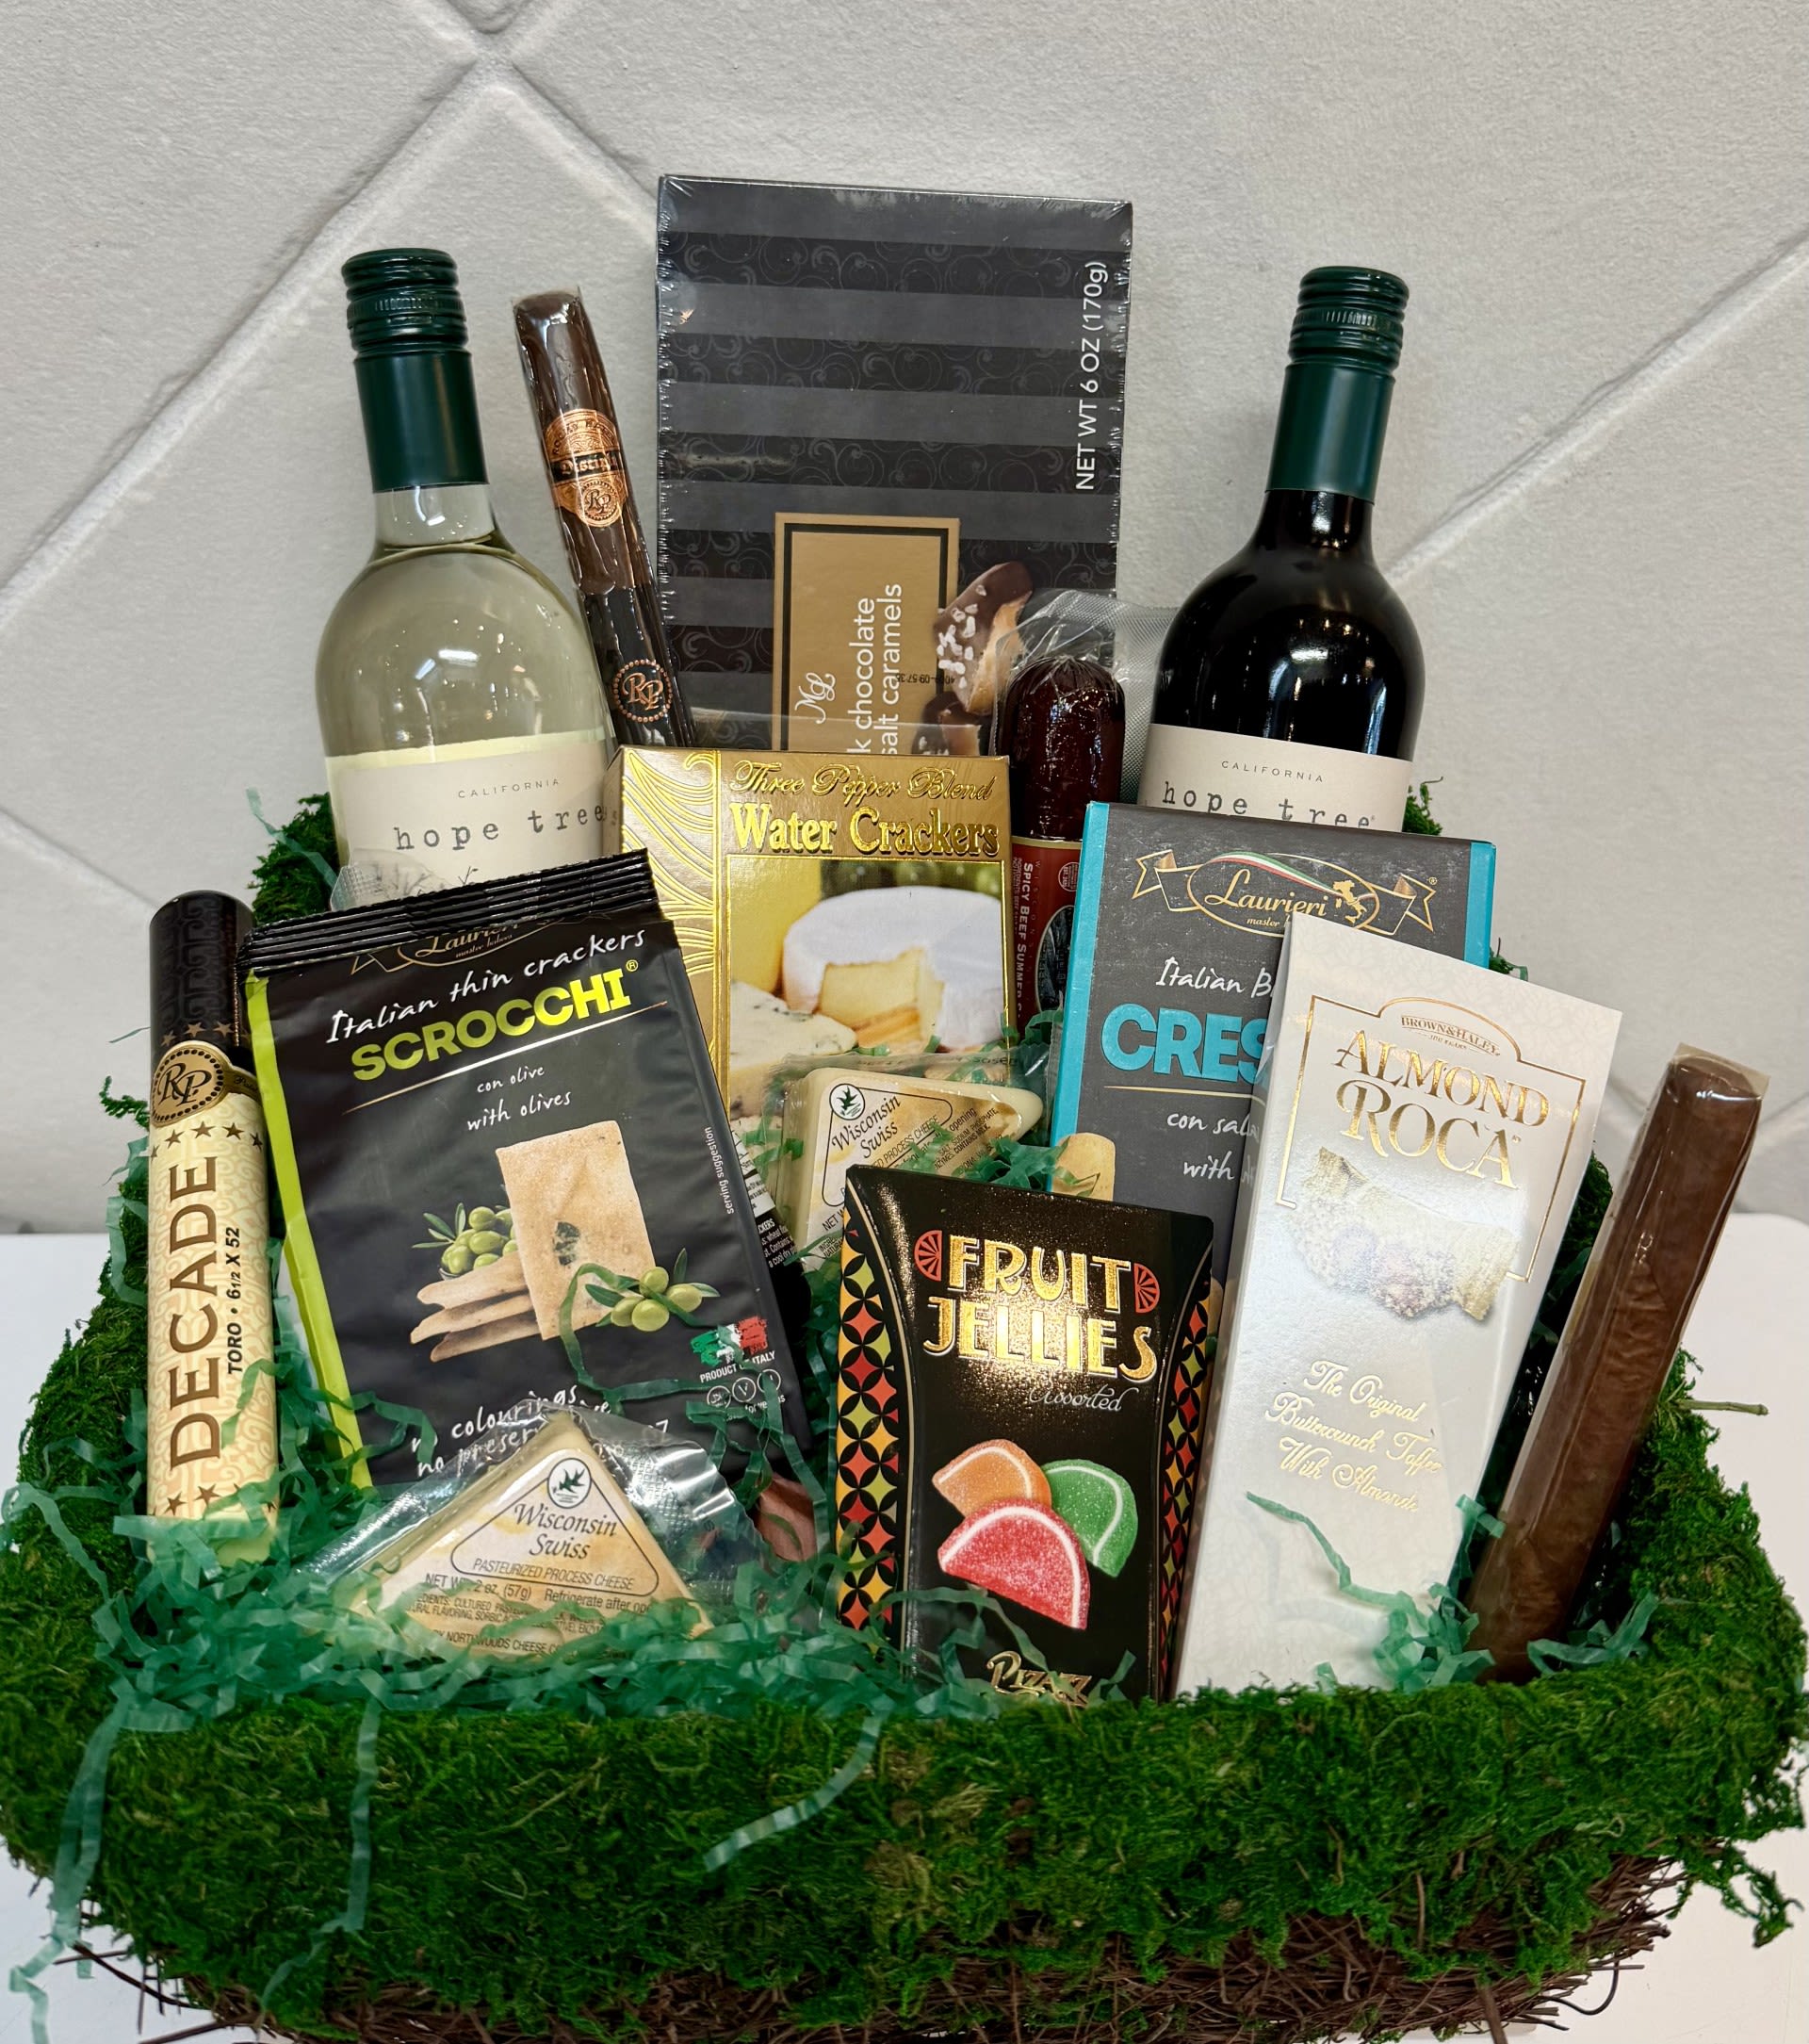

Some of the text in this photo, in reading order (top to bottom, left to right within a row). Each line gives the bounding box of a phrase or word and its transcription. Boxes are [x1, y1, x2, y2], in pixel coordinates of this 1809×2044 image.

[1075, 261, 1109, 491] NET WT 6 OZ (170g)
[847, 597, 875, 730] chocolate
[876, 583, 902, 705] caramels
[622, 672, 664, 711] RP
[458, 777, 560, 799] CALIFORNIA
[730, 760, 997, 807] Three Pepper Blend
[1221, 760, 1324, 783] CALIFORNIA
[1161, 780, 1371, 828] hope tree
[393, 804, 606, 851] hope tree
[728, 801, 1000, 857] Water Crackers
[1021, 862, 1034, 902] SPICY
[1204, 868, 1328, 917] Laurieri
[1018, 907, 1030, 940] BEEF
[1247, 916, 1280, 928] master
[325, 927, 645, 1044] Italian thin crackers
[1155, 956, 1247, 993] Italian
[351, 968, 631, 1081] SCROCCHI
[1100, 1003, 1269, 1086] CRES
[157, 1062, 213, 1107] RP
[477, 1065, 546, 1093] con olive
[1331, 1029, 1551, 1127] ALMOND
[466, 1090, 572, 1131] with olives
[831, 1095, 901, 1153] Wisconsin
[949, 1107, 979, 1132] opening
[1166, 1113, 1209, 1130] con
[860, 1120, 899, 1160] Swiss
[883, 1137, 916, 1164] PROCESS
[1335, 1079, 1520, 1190] ROCA
[704, 1126, 735, 1215] serving suggestion
[1182, 1150, 1235, 1181] with
[225, 1226, 241, 1251] 52
[822, 1215, 839, 1232] NET
[226, 1251, 241, 1267] X
[947, 1234, 1132, 1315] FRUIT
[168, 1155, 221, 1471] DECADE
[227, 1321, 244, 1375] TORO
[922, 1296, 1159, 1382] JELLIES
[699, 1363, 738, 1383] PRODUCT
[1303, 1360, 1427, 1422] The Original
[1030, 1382, 1140, 1412] Assorted
[1264, 1391, 1442, 1477] Buttercrunch Toffee
[417, 1456, 445, 1478] no
[1279, 1436, 1419, 1513] With Almonds
[514, 1502, 618, 1537] Wisconsin
[529, 1532, 592, 1560] Swiss
[425, 1573, 447, 1588] NET
[502, 1584, 532, 1601] (57g)
[605, 1596, 630, 1611] after
[473, 1558, 635, 1591] PASTEURIZED PROCESS CHEESE
